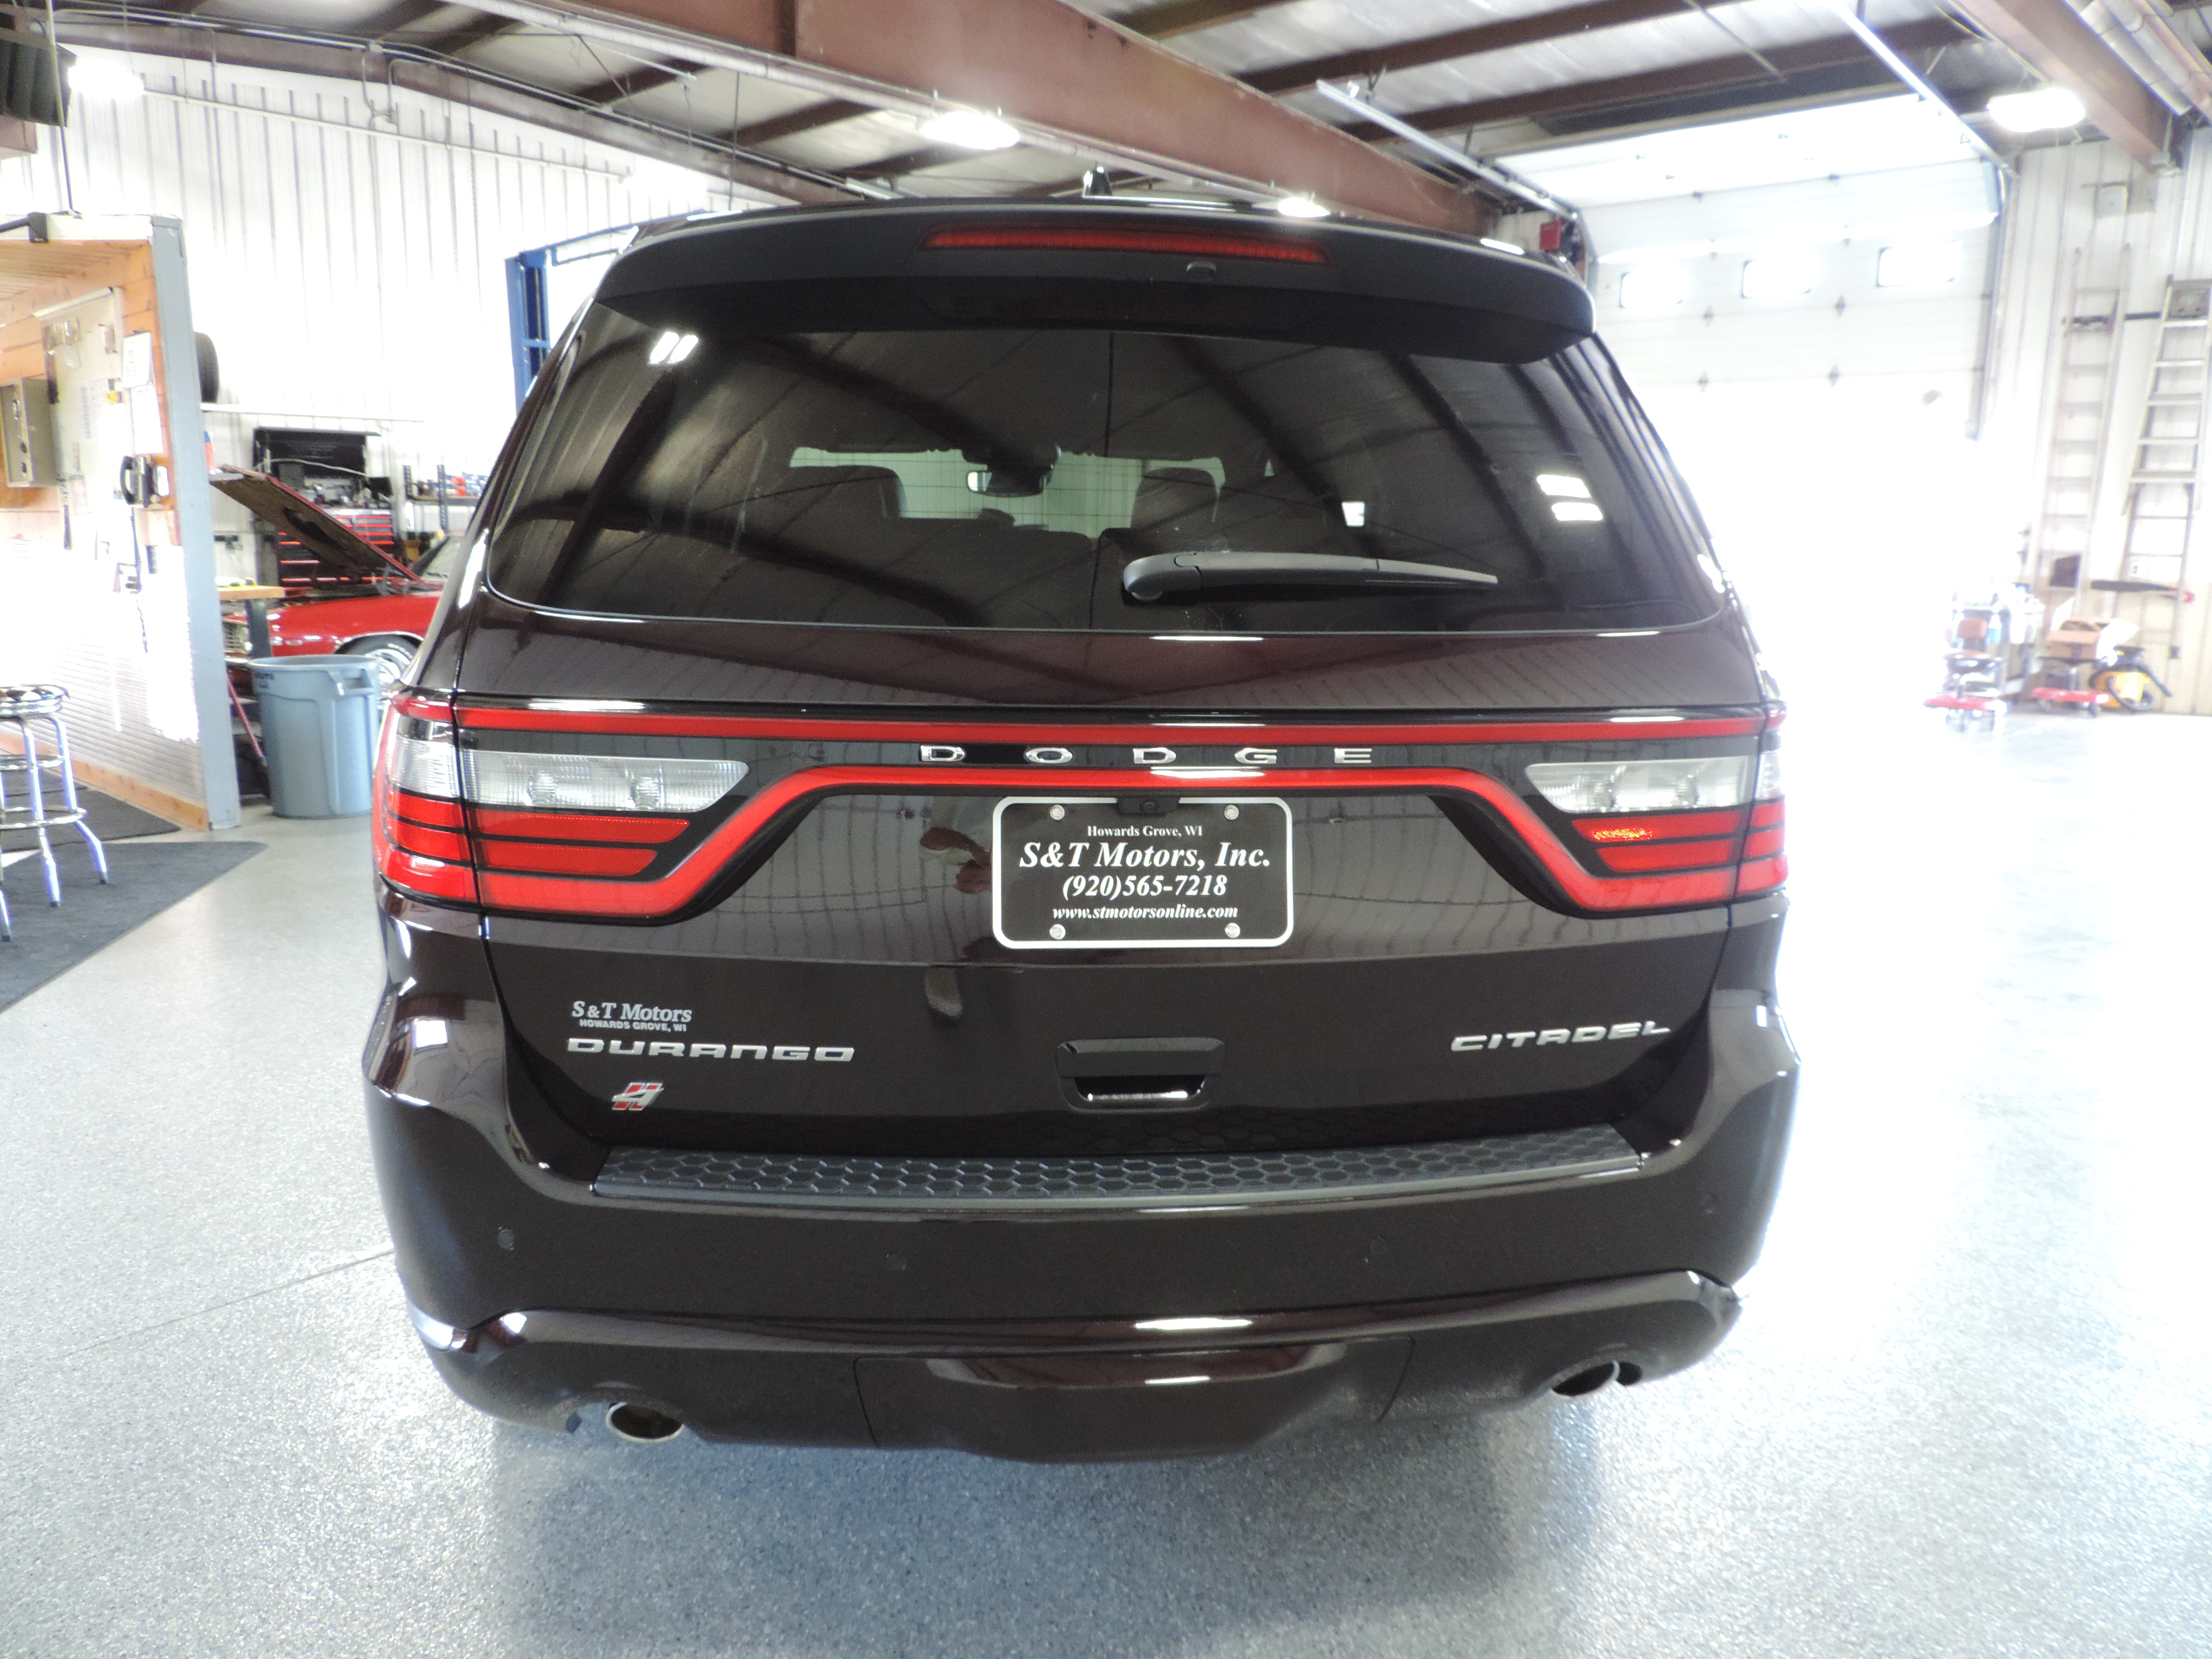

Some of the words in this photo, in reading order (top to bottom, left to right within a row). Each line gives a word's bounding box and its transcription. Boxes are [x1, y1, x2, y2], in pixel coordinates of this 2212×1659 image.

[919, 746, 1372, 764] DODGE
[1087, 825, 1140, 836] Howards
[1143, 825, 1182, 837] Grove,
[1185, 825, 1202, 836] WI
[1019, 842, 1090, 867] S&T
[1093, 842, 1205, 872] Motors,
[1214, 842, 1270, 867] Inc.
[1063, 875, 1228, 901] (920)565-7218
[1053, 904, 1238, 919] www.stmotorsonline.com
[620, 1003, 692, 1022] Motors
[579, 1019, 631, 1029] HOWARDS
[632, 1022, 671, 1032] GROVE,
[673, 1024, 687, 1032] WI
[1451, 1020, 1671, 1052] CITADEL
[567, 1038, 855, 1062] DURANGO
